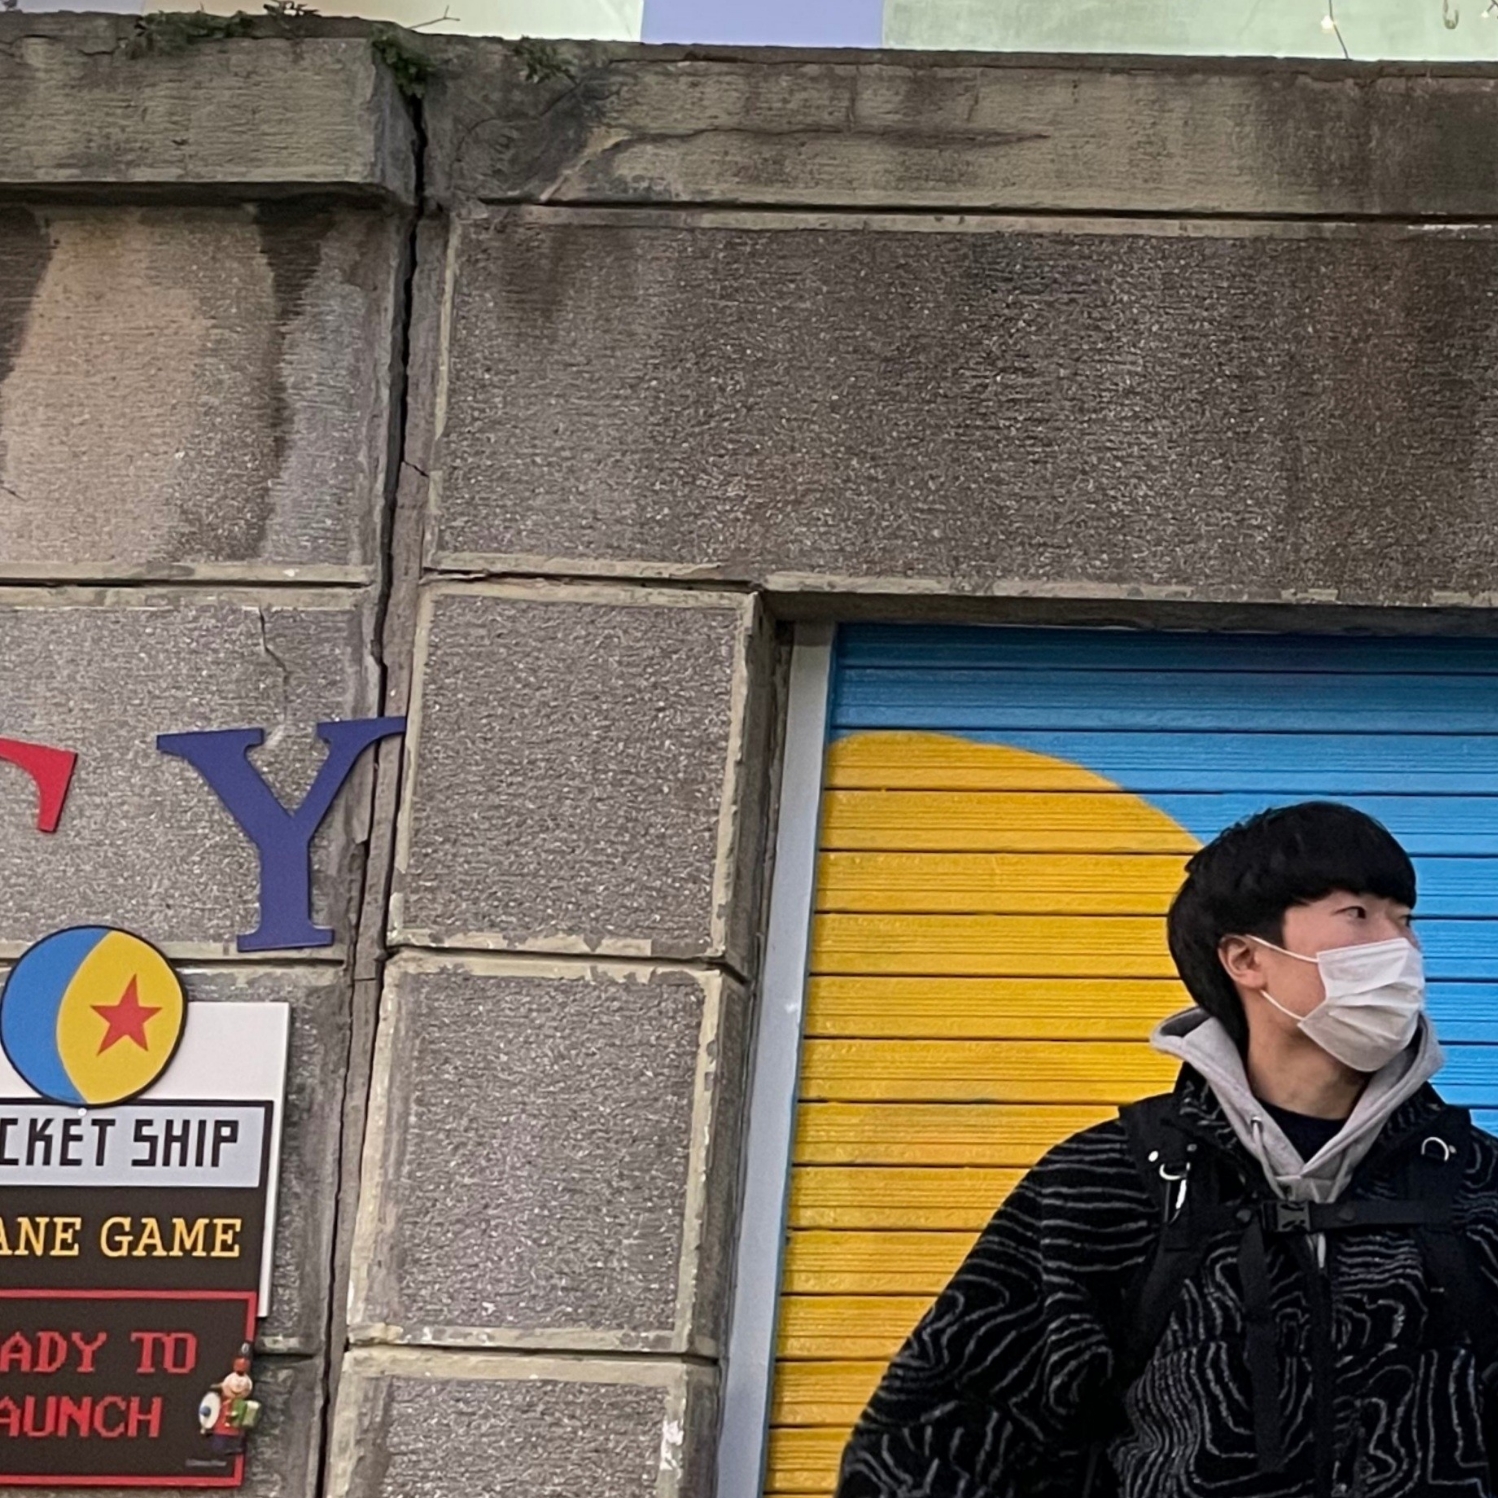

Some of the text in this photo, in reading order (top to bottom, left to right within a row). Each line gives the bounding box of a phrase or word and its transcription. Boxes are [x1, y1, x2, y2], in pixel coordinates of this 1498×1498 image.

[131, 1119, 240, 1168] SHIP
[100, 1217, 242, 1258] GAME
[0, 1331, 197, 1374] ADY TO
